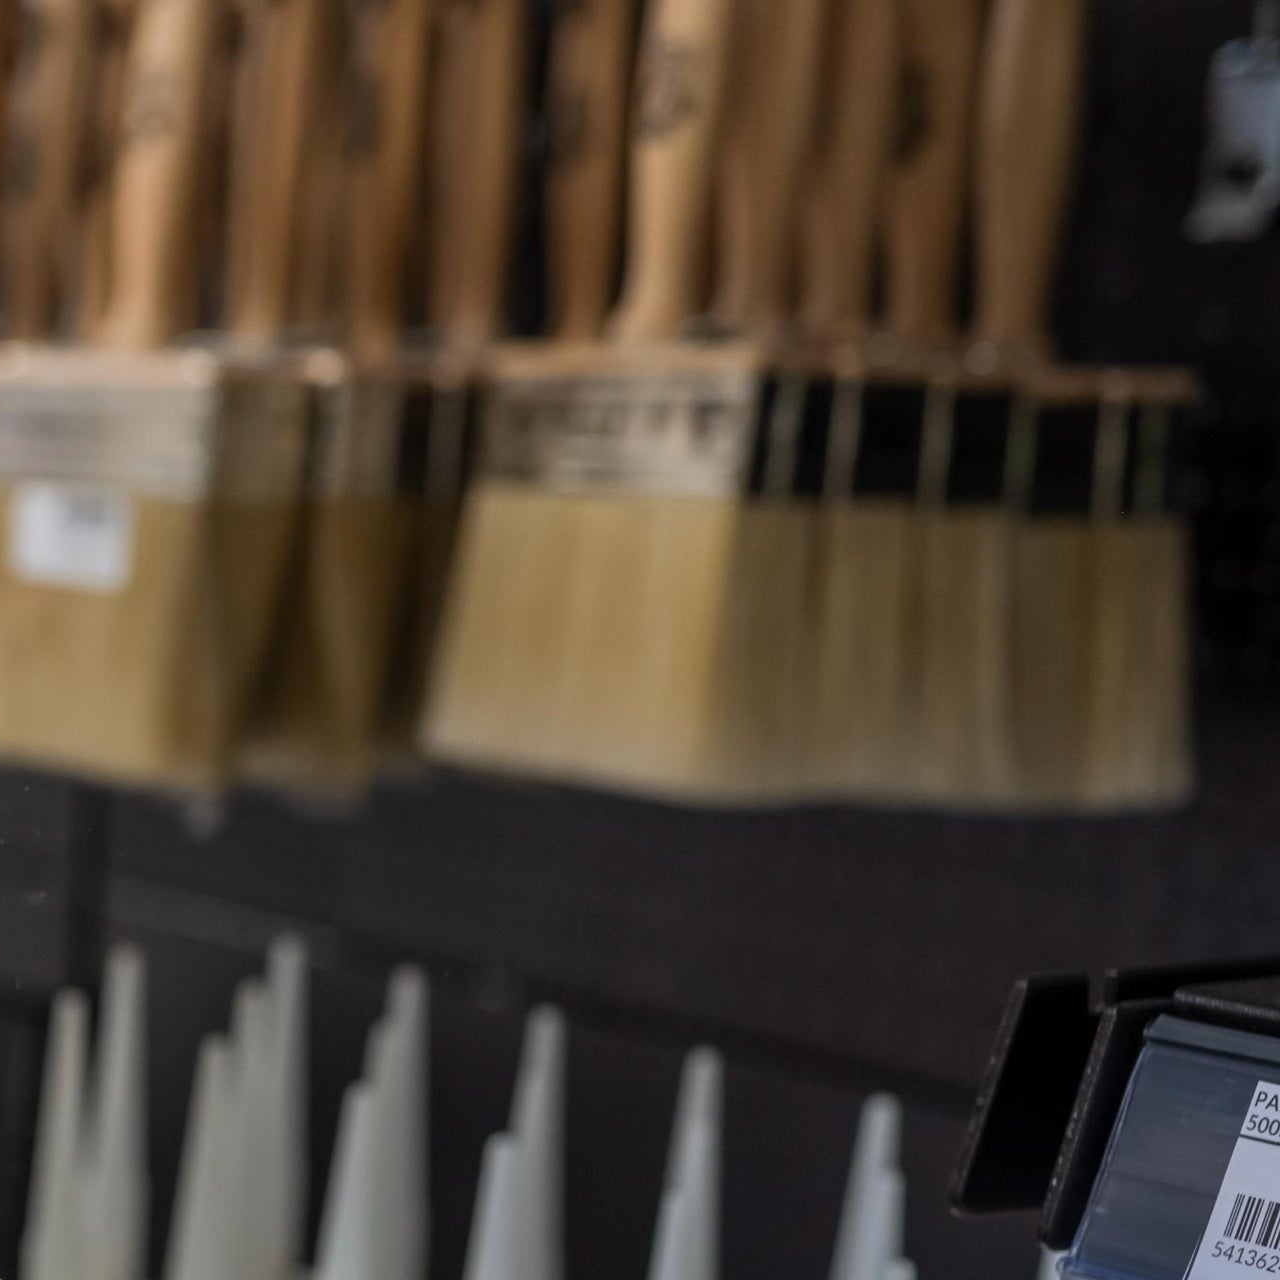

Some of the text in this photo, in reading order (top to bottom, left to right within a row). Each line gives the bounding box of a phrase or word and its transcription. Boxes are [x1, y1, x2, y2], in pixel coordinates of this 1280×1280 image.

[1255, 1090, 1280, 1113] PA
[1246, 1114, 1280, 1137] 500
[1211, 1240, 1280, 1274] 541362
